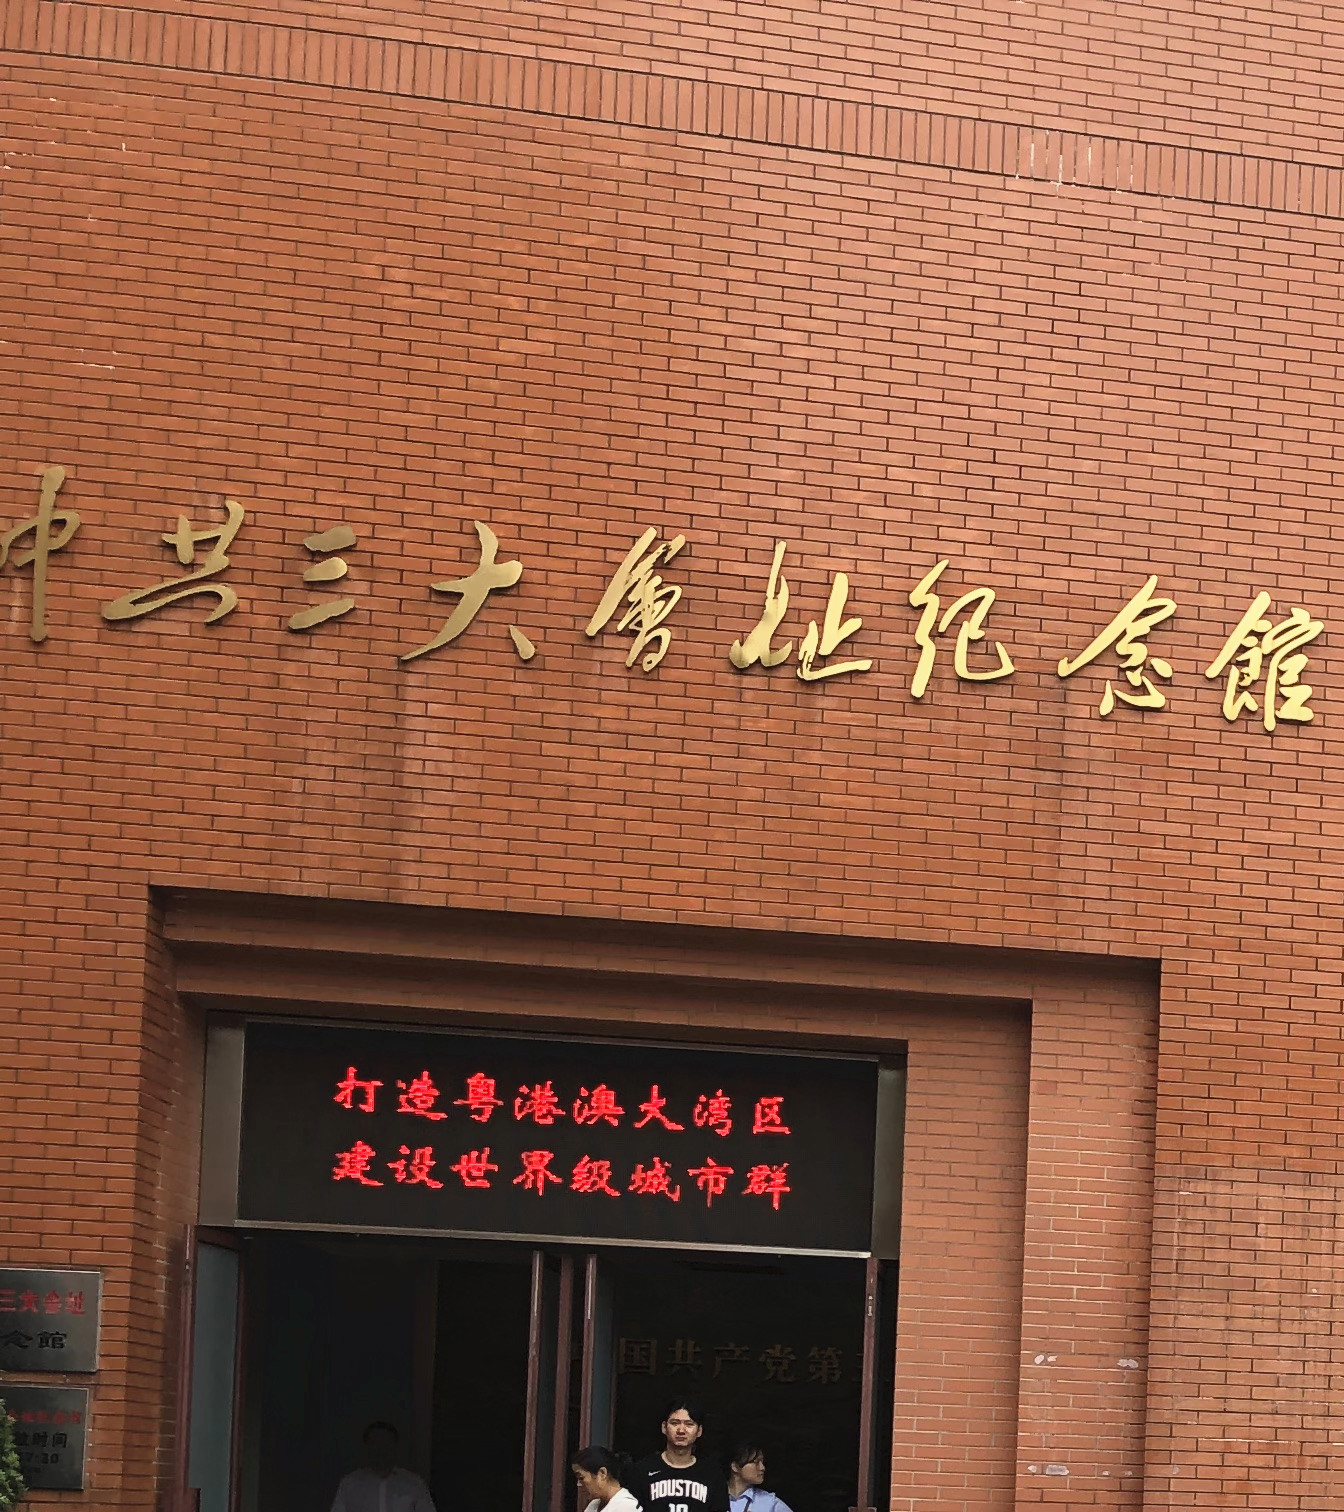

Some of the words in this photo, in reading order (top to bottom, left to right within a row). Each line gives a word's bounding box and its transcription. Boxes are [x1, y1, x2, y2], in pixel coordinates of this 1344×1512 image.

[334, 1066, 792, 1138] 打造粤港澳大湾区
[331, 1140, 792, 1211] 建设世界级城市群
[650, 1479, 708, 1503] HOUSTON
